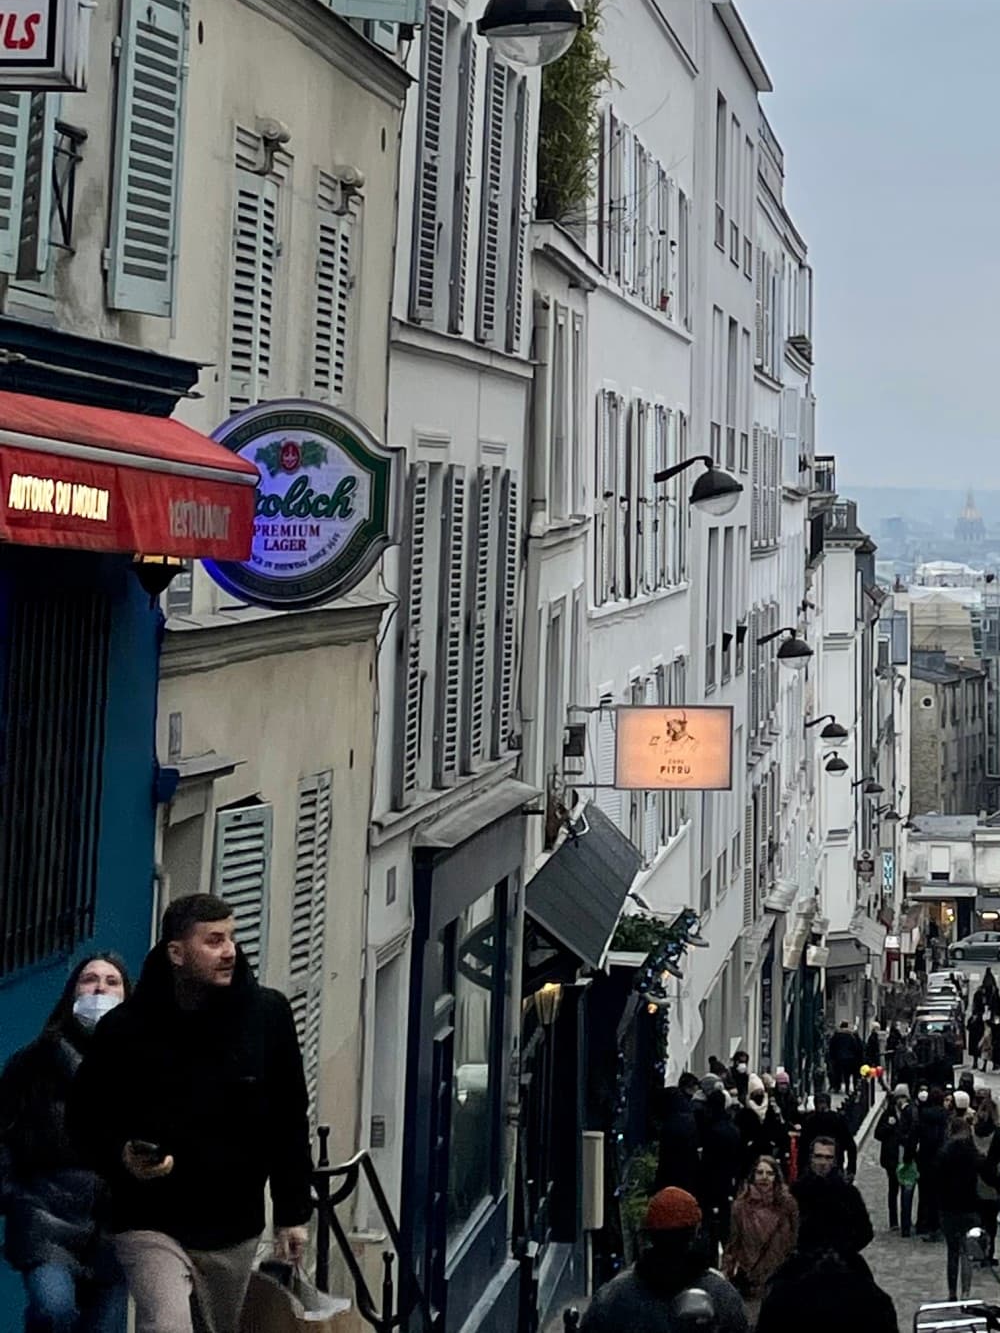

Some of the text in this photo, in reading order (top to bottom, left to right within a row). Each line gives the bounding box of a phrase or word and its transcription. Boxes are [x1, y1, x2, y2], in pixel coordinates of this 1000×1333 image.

[8, 473, 109, 522] AUTOUR DU MOULIN
[253, 524, 320, 537] PREMIUM
[263, 538, 307, 552] LAGER
